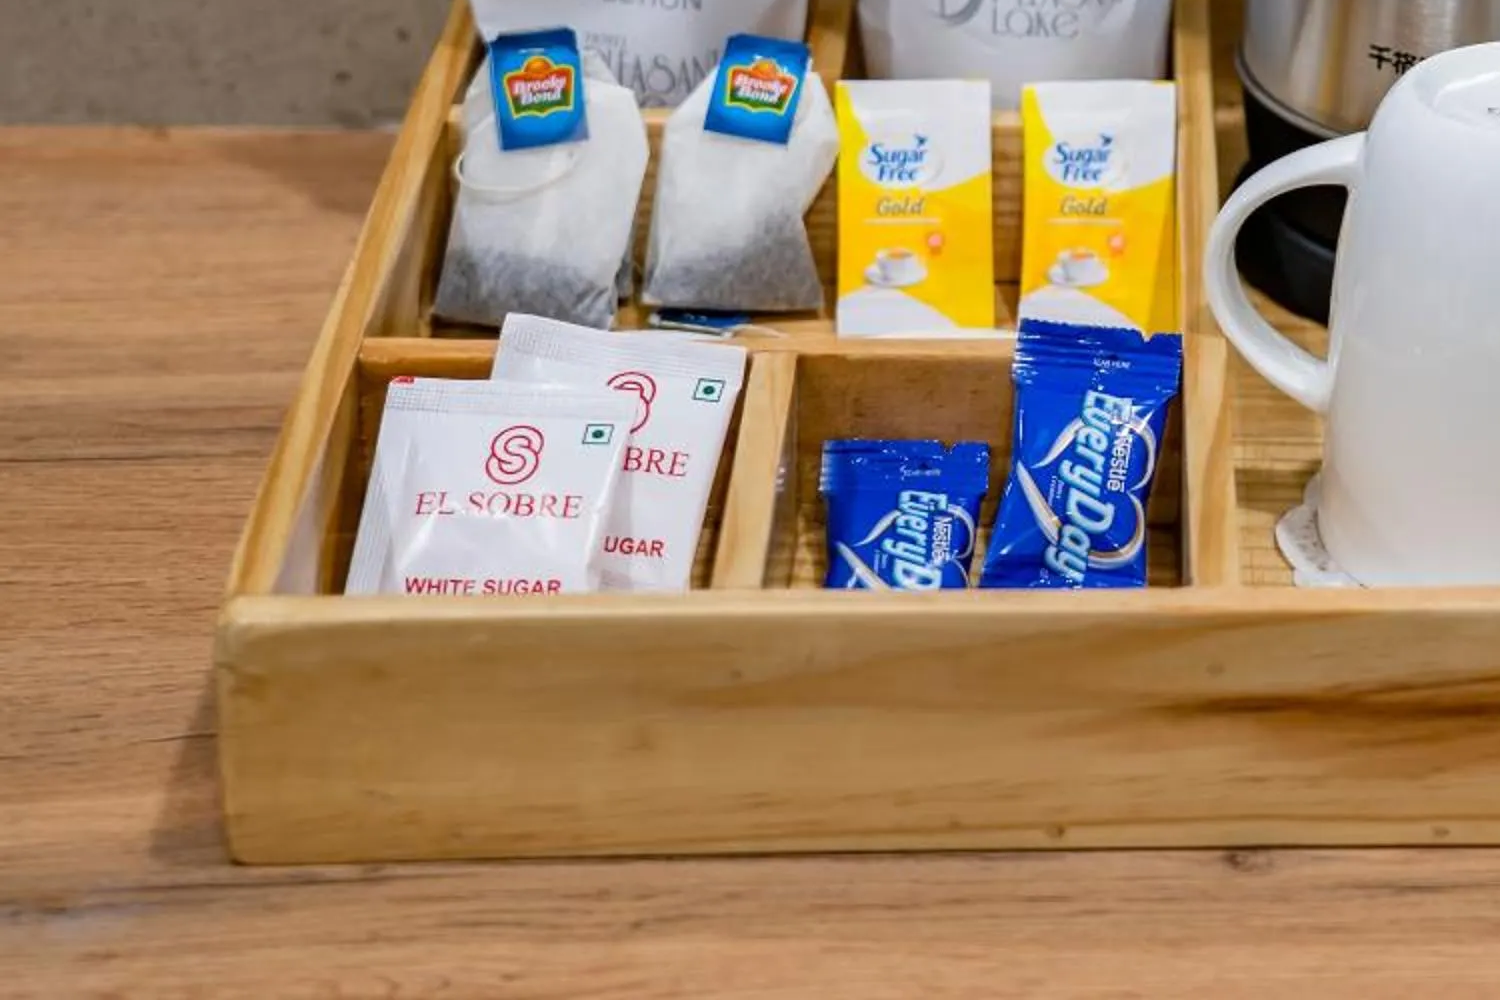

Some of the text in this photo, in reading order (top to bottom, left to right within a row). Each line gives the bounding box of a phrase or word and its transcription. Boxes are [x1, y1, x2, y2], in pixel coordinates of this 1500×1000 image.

[868, 143, 929, 168] Sugar
[1054, 142, 1112, 166] Sugar
[876, 164, 919, 182] Free
[1062, 163, 1104, 182] Free
[876, 196, 924, 216] Gold
[1060, 196, 1108, 216] Gold
[622, 445, 690, 478] BRE
[1044, 389, 1134, 584] EveryDay
[415, 491, 584, 520] EL SOBRE
[604, 535, 665, 558] UGAR
[405, 577, 562, 597] WHITE SUGAR
